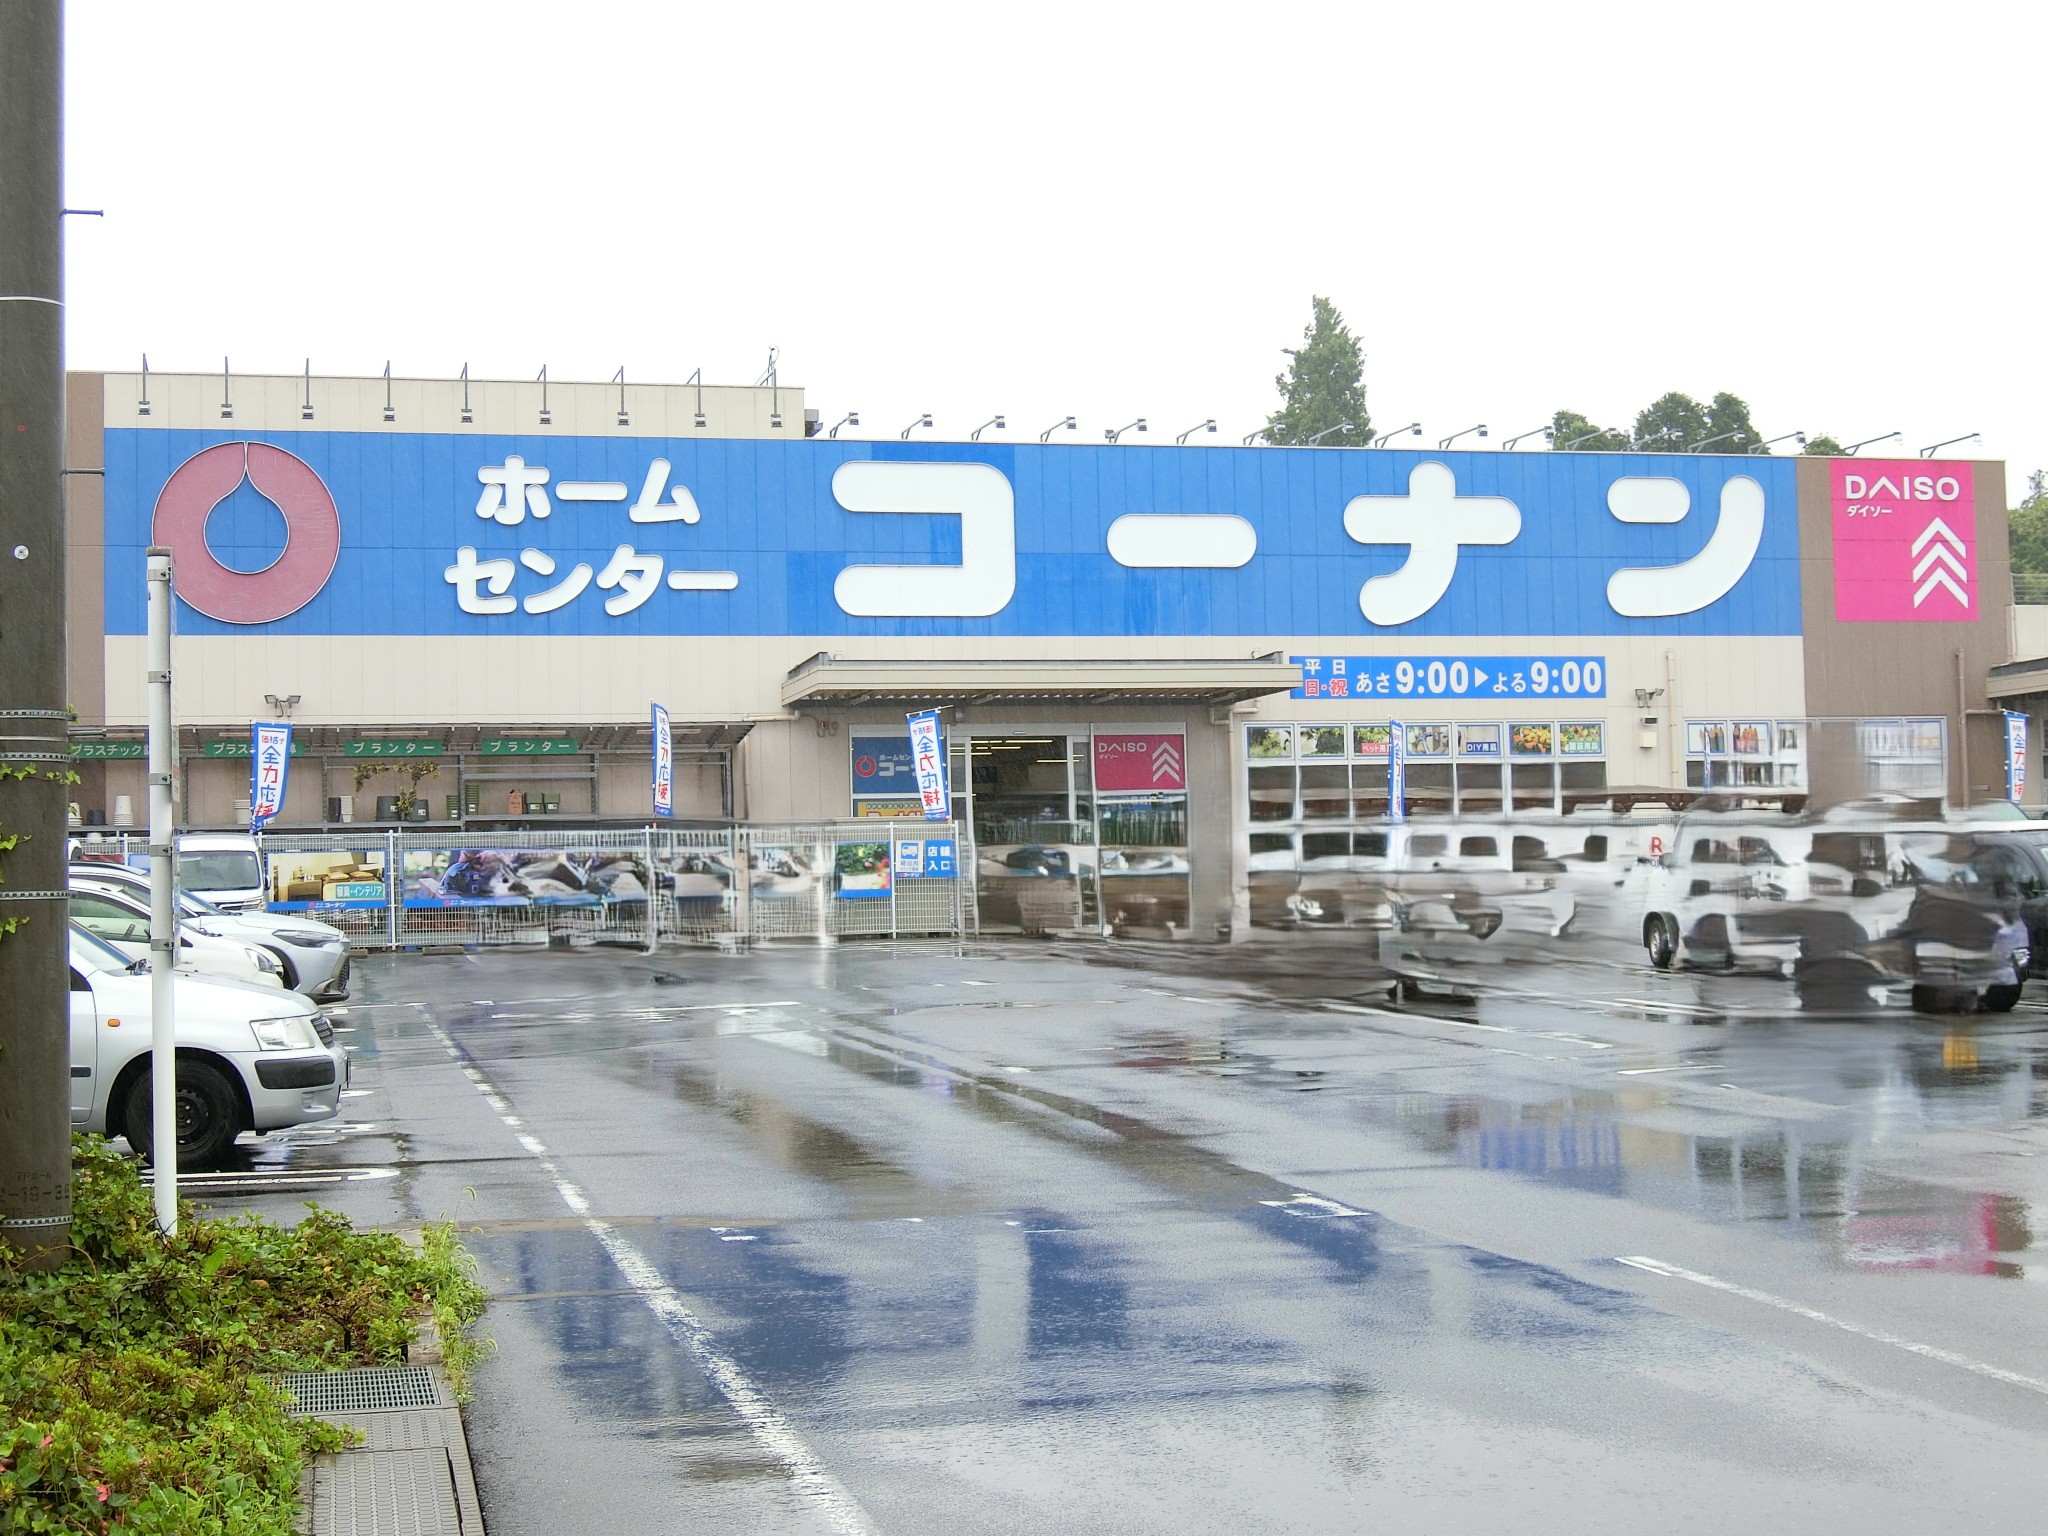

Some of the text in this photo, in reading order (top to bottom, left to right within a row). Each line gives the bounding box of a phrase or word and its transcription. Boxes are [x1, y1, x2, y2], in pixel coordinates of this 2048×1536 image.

[475, 457, 701, 526] ホーム
[1845, 475, 1960, 501] DAISO
[1846, 504, 1893, 518] ダイソー
[832, 459, 1766, 626] コーナン
[444, 544, 740, 617] センター
[353, 743, 435, 753] プランター
[489, 741, 570, 752] プランター
[1098, 742, 1147, 752] DAISO
[1467, 743, 1498, 752] DIY用品
[928, 860, 951, 871] 入口
